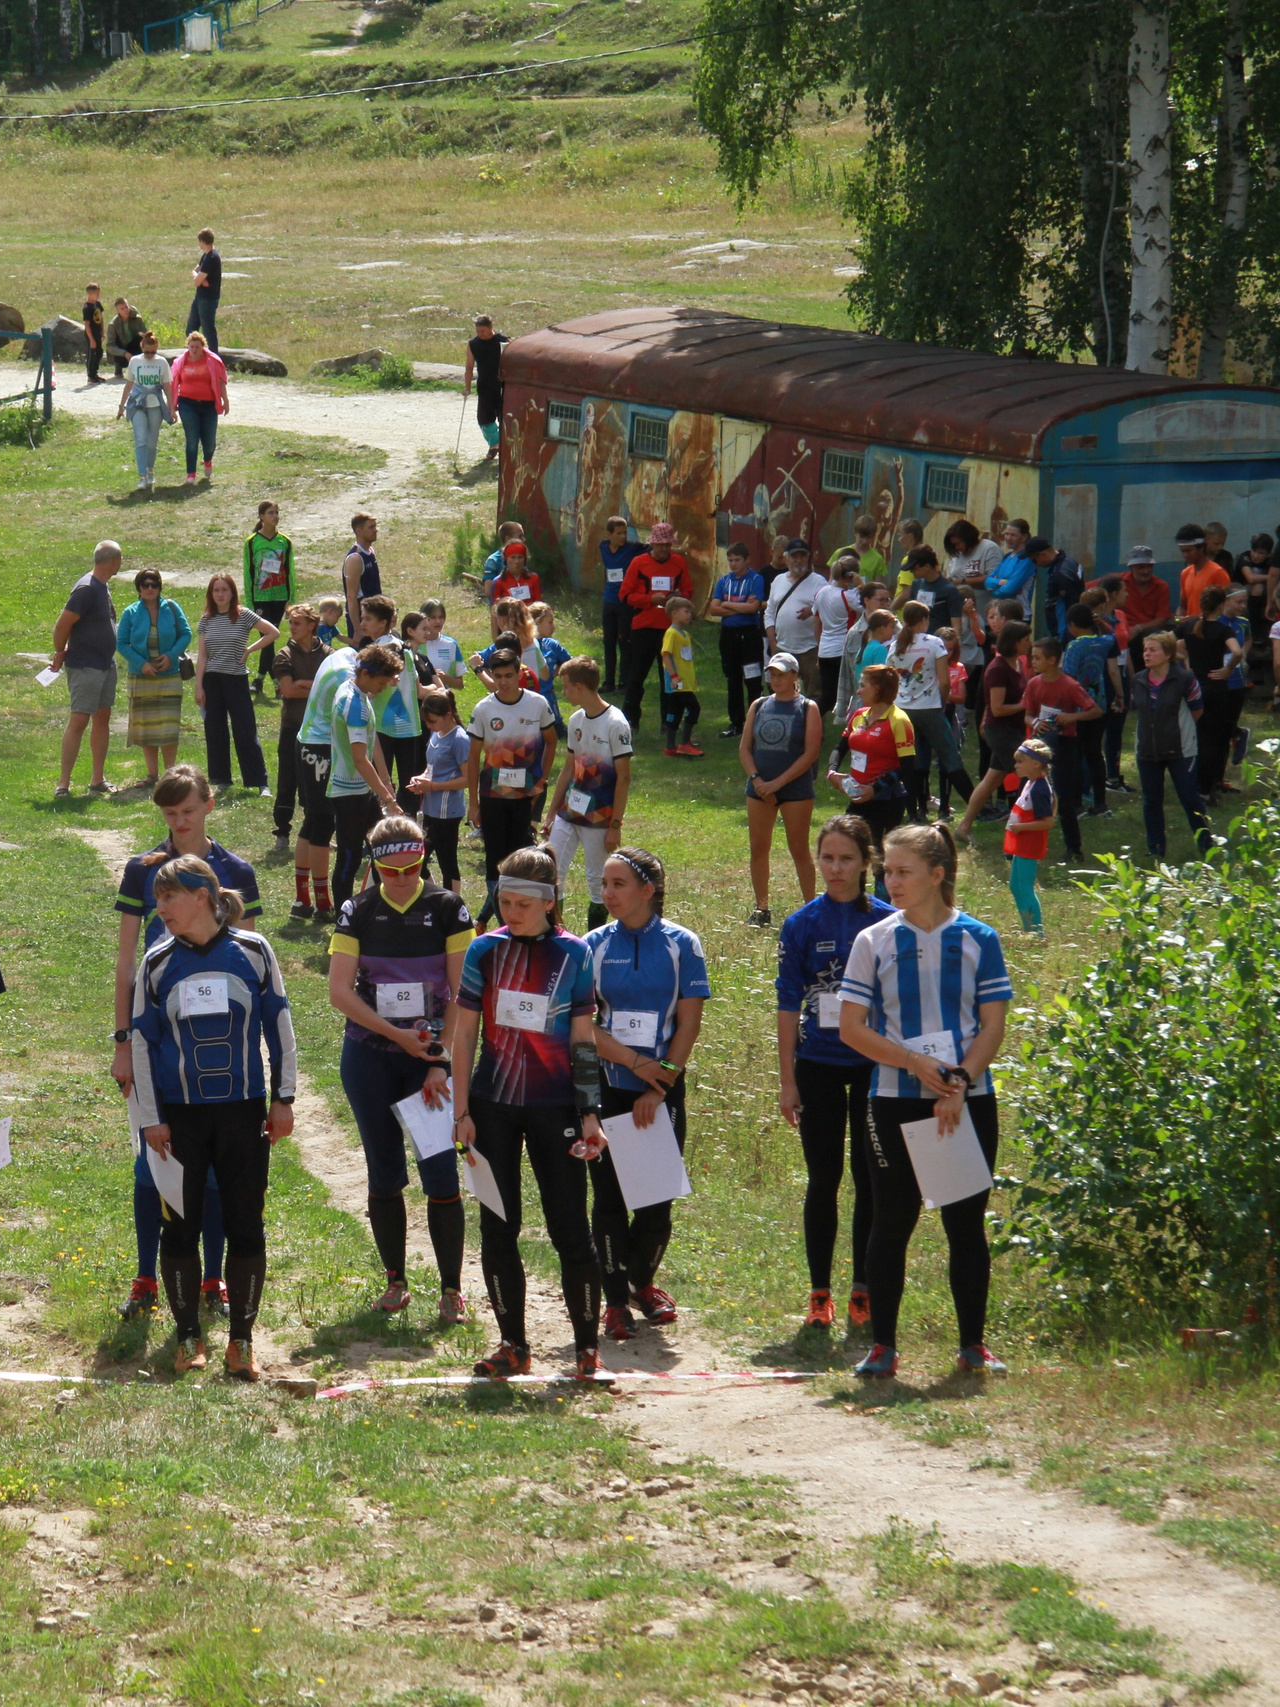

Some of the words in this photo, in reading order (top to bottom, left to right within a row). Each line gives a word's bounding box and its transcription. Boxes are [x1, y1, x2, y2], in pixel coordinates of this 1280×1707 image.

[372, 842, 424, 857] TRIMTEX
[198, 985, 212, 996] 56
[397, 991, 410, 1001] 62
[518, 1001, 533, 1012] 53
[629, 1018, 642, 1029] 61
[923, 1043, 937, 1055] 51
